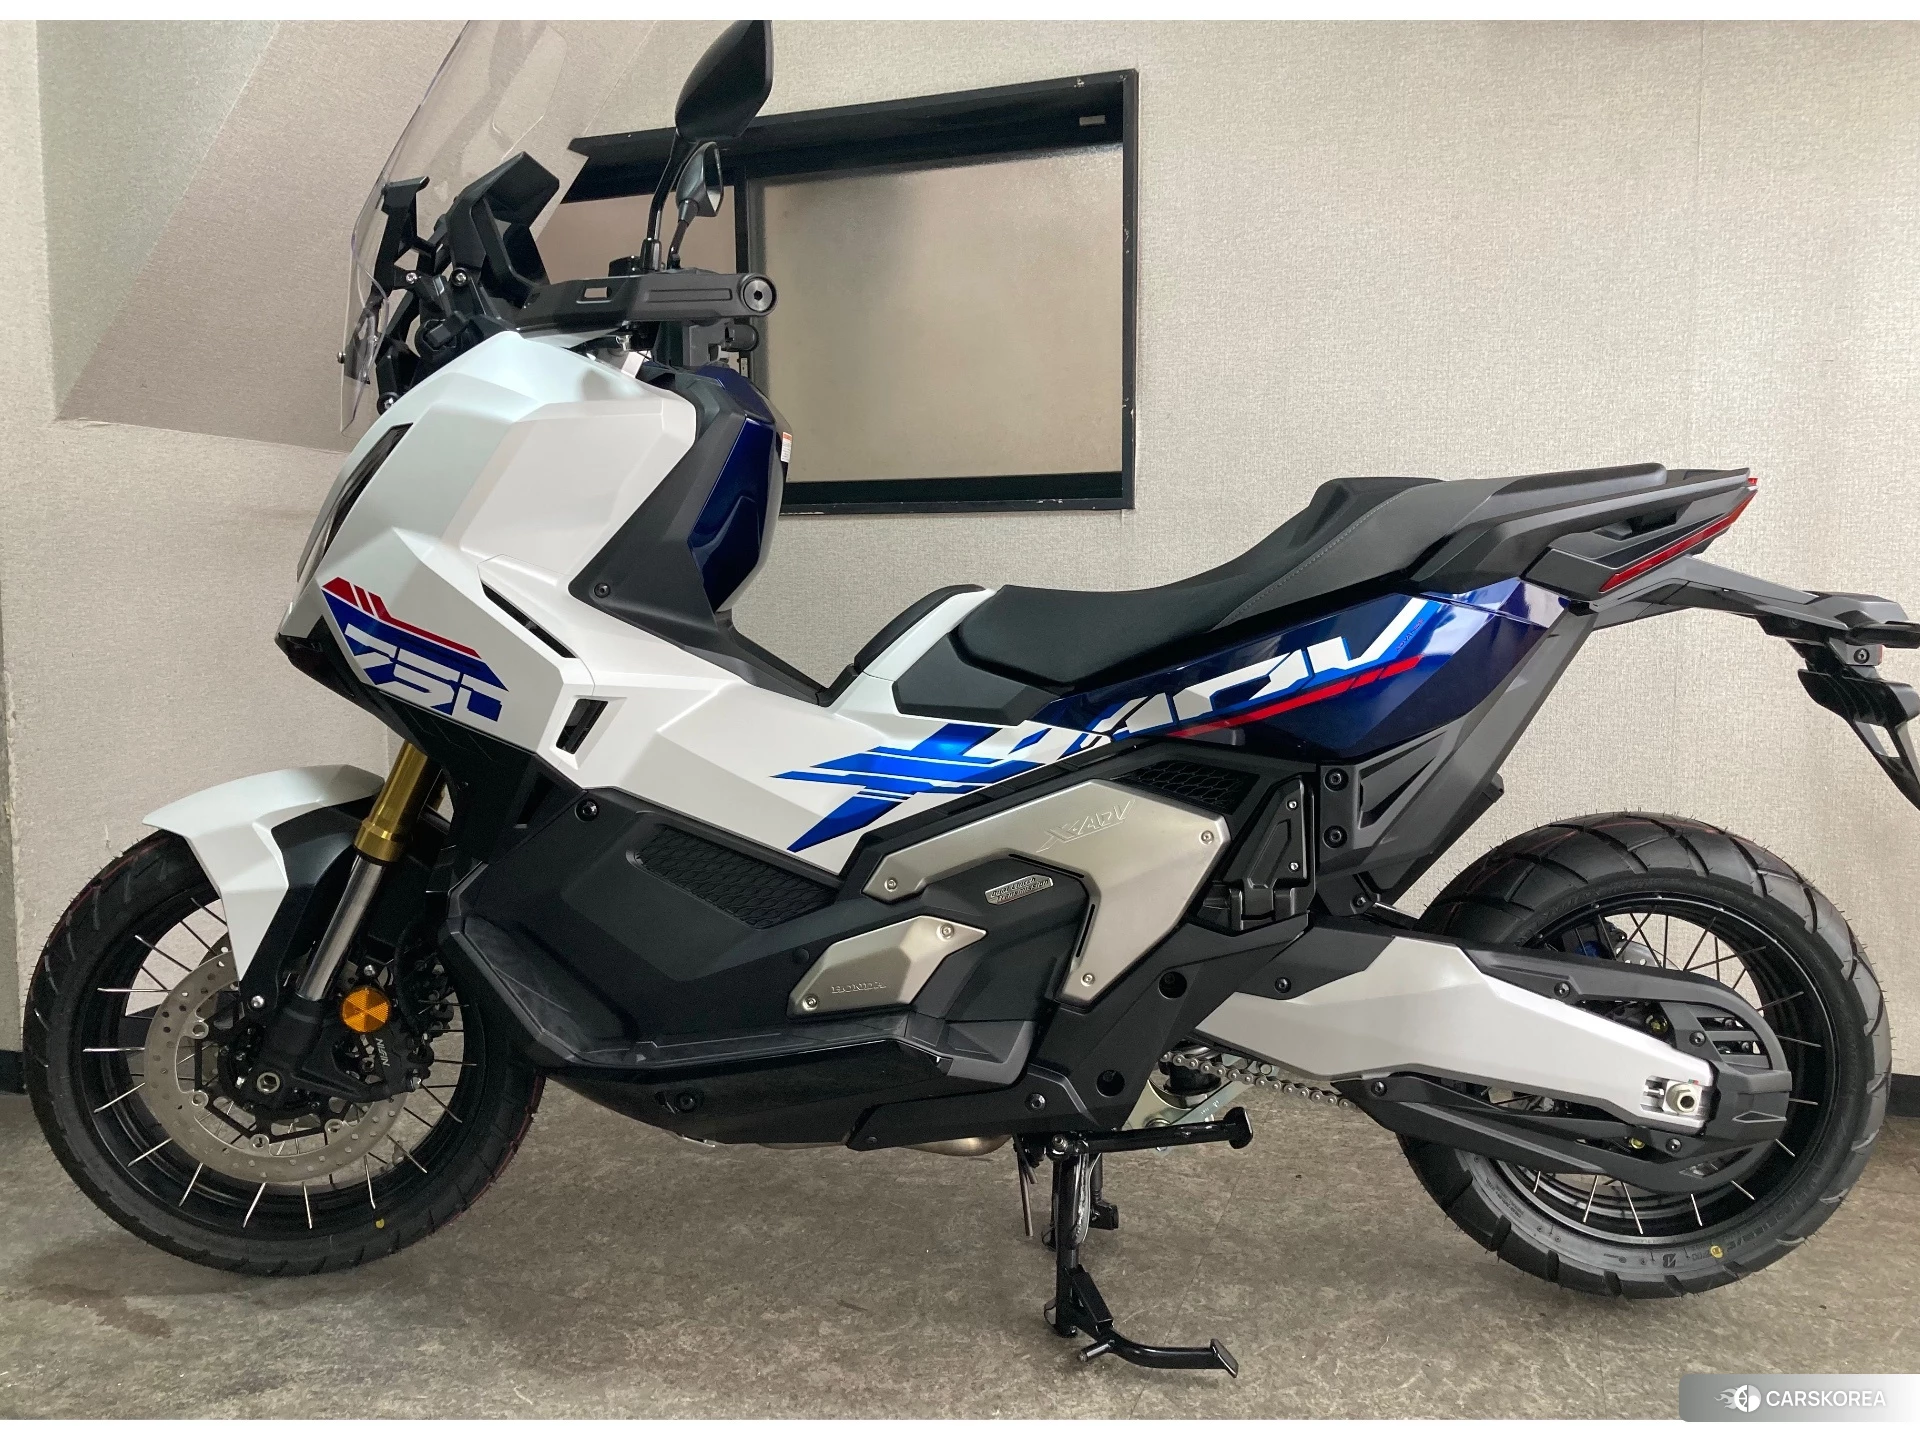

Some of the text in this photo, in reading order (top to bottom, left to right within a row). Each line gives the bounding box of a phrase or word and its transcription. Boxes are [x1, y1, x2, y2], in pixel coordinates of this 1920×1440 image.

[343, 622, 503, 726] 750
[1035, 798, 1136, 854] X-ADV
[831, 981, 887, 994] HONDA
[375, 1037, 391, 1067] NISSIN
